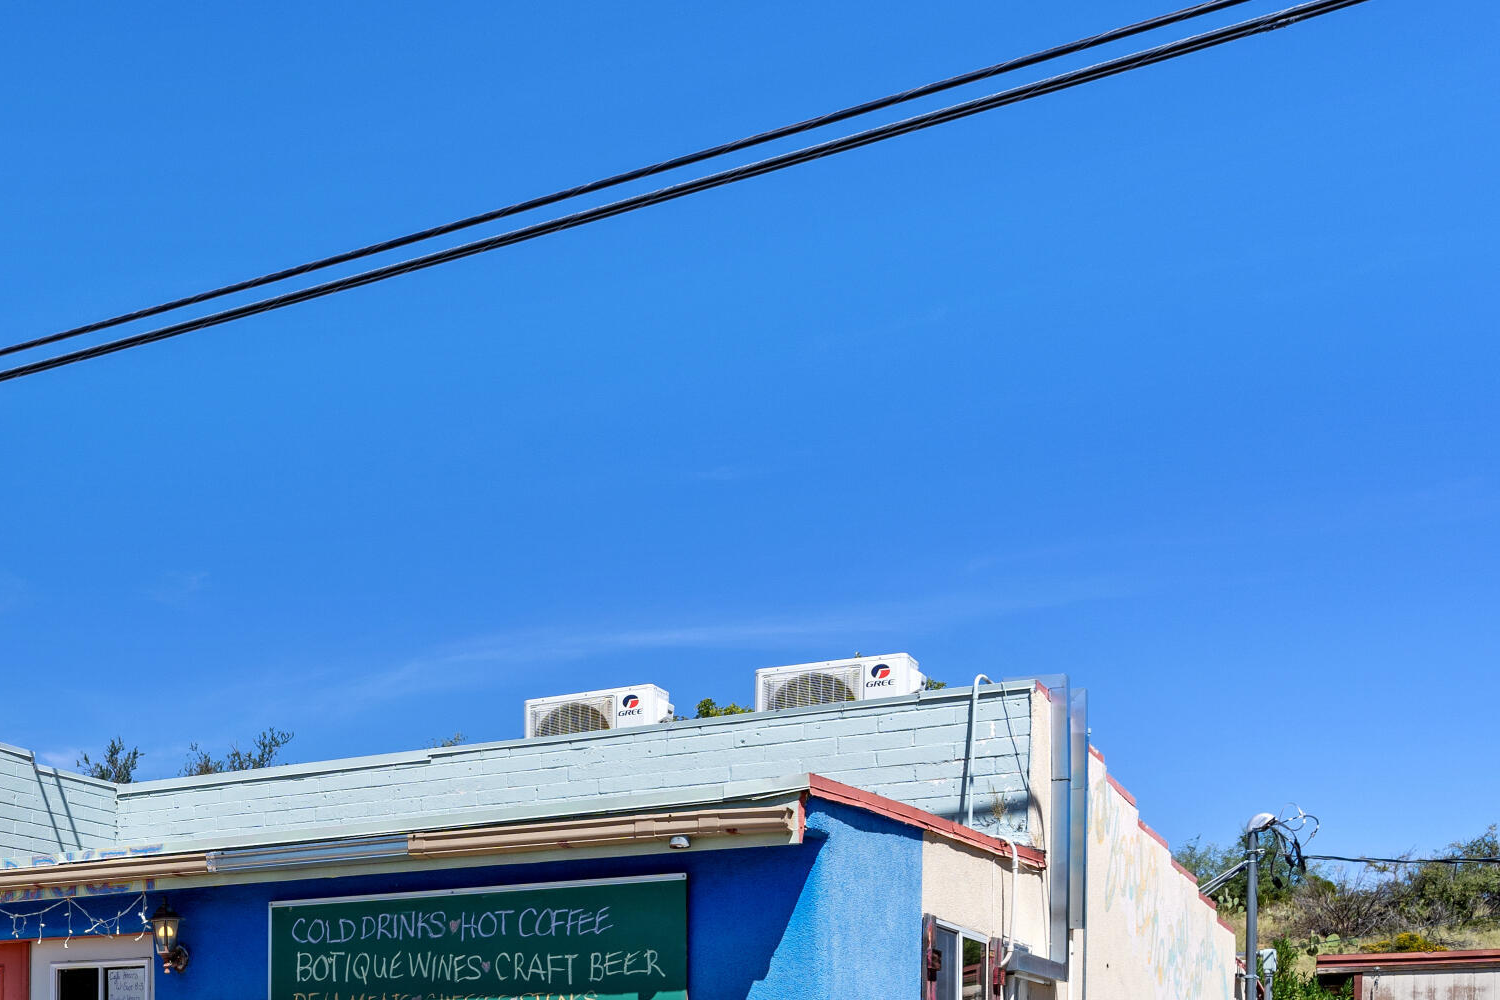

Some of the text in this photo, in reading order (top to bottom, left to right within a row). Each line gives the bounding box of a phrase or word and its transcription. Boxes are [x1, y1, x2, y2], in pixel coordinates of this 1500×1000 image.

[866, 679, 896, 688] GREE
[618, 708, 644, 717] GREE
[291, 906, 614, 944] COLD DRINKS HOT COFFEE
[408, 951, 483, 983] WINES
[495, 952, 579, 985] CRAFT
[589, 949, 666, 982] BEER
